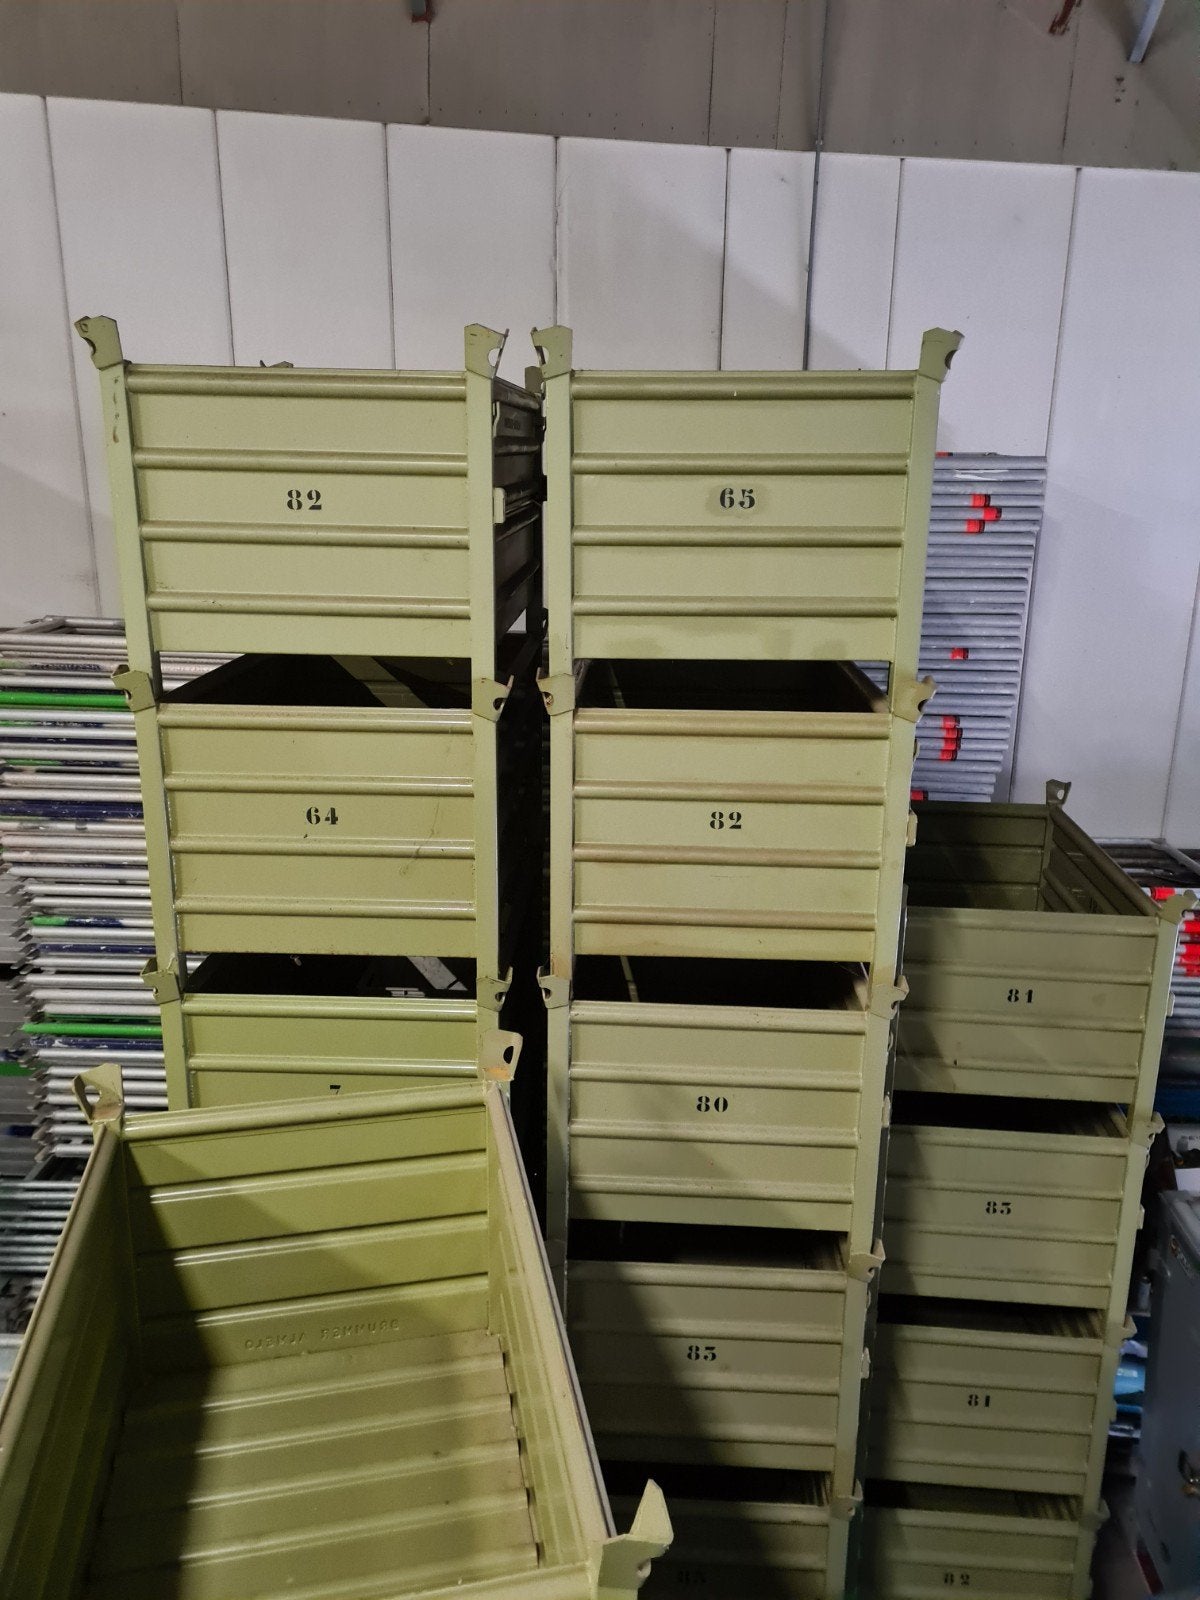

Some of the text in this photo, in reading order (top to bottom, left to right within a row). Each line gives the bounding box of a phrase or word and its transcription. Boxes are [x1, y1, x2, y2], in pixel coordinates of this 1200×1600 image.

[286, 489, 322, 511] 82
[719, 487, 756, 510] 65
[306, 806, 340, 825] 64
[709, 811, 742, 830] 82
[1007, 988, 1034, 1004] 81
[696, 1095, 729, 1112] 80
[967, 1394, 991, 1408] 81
